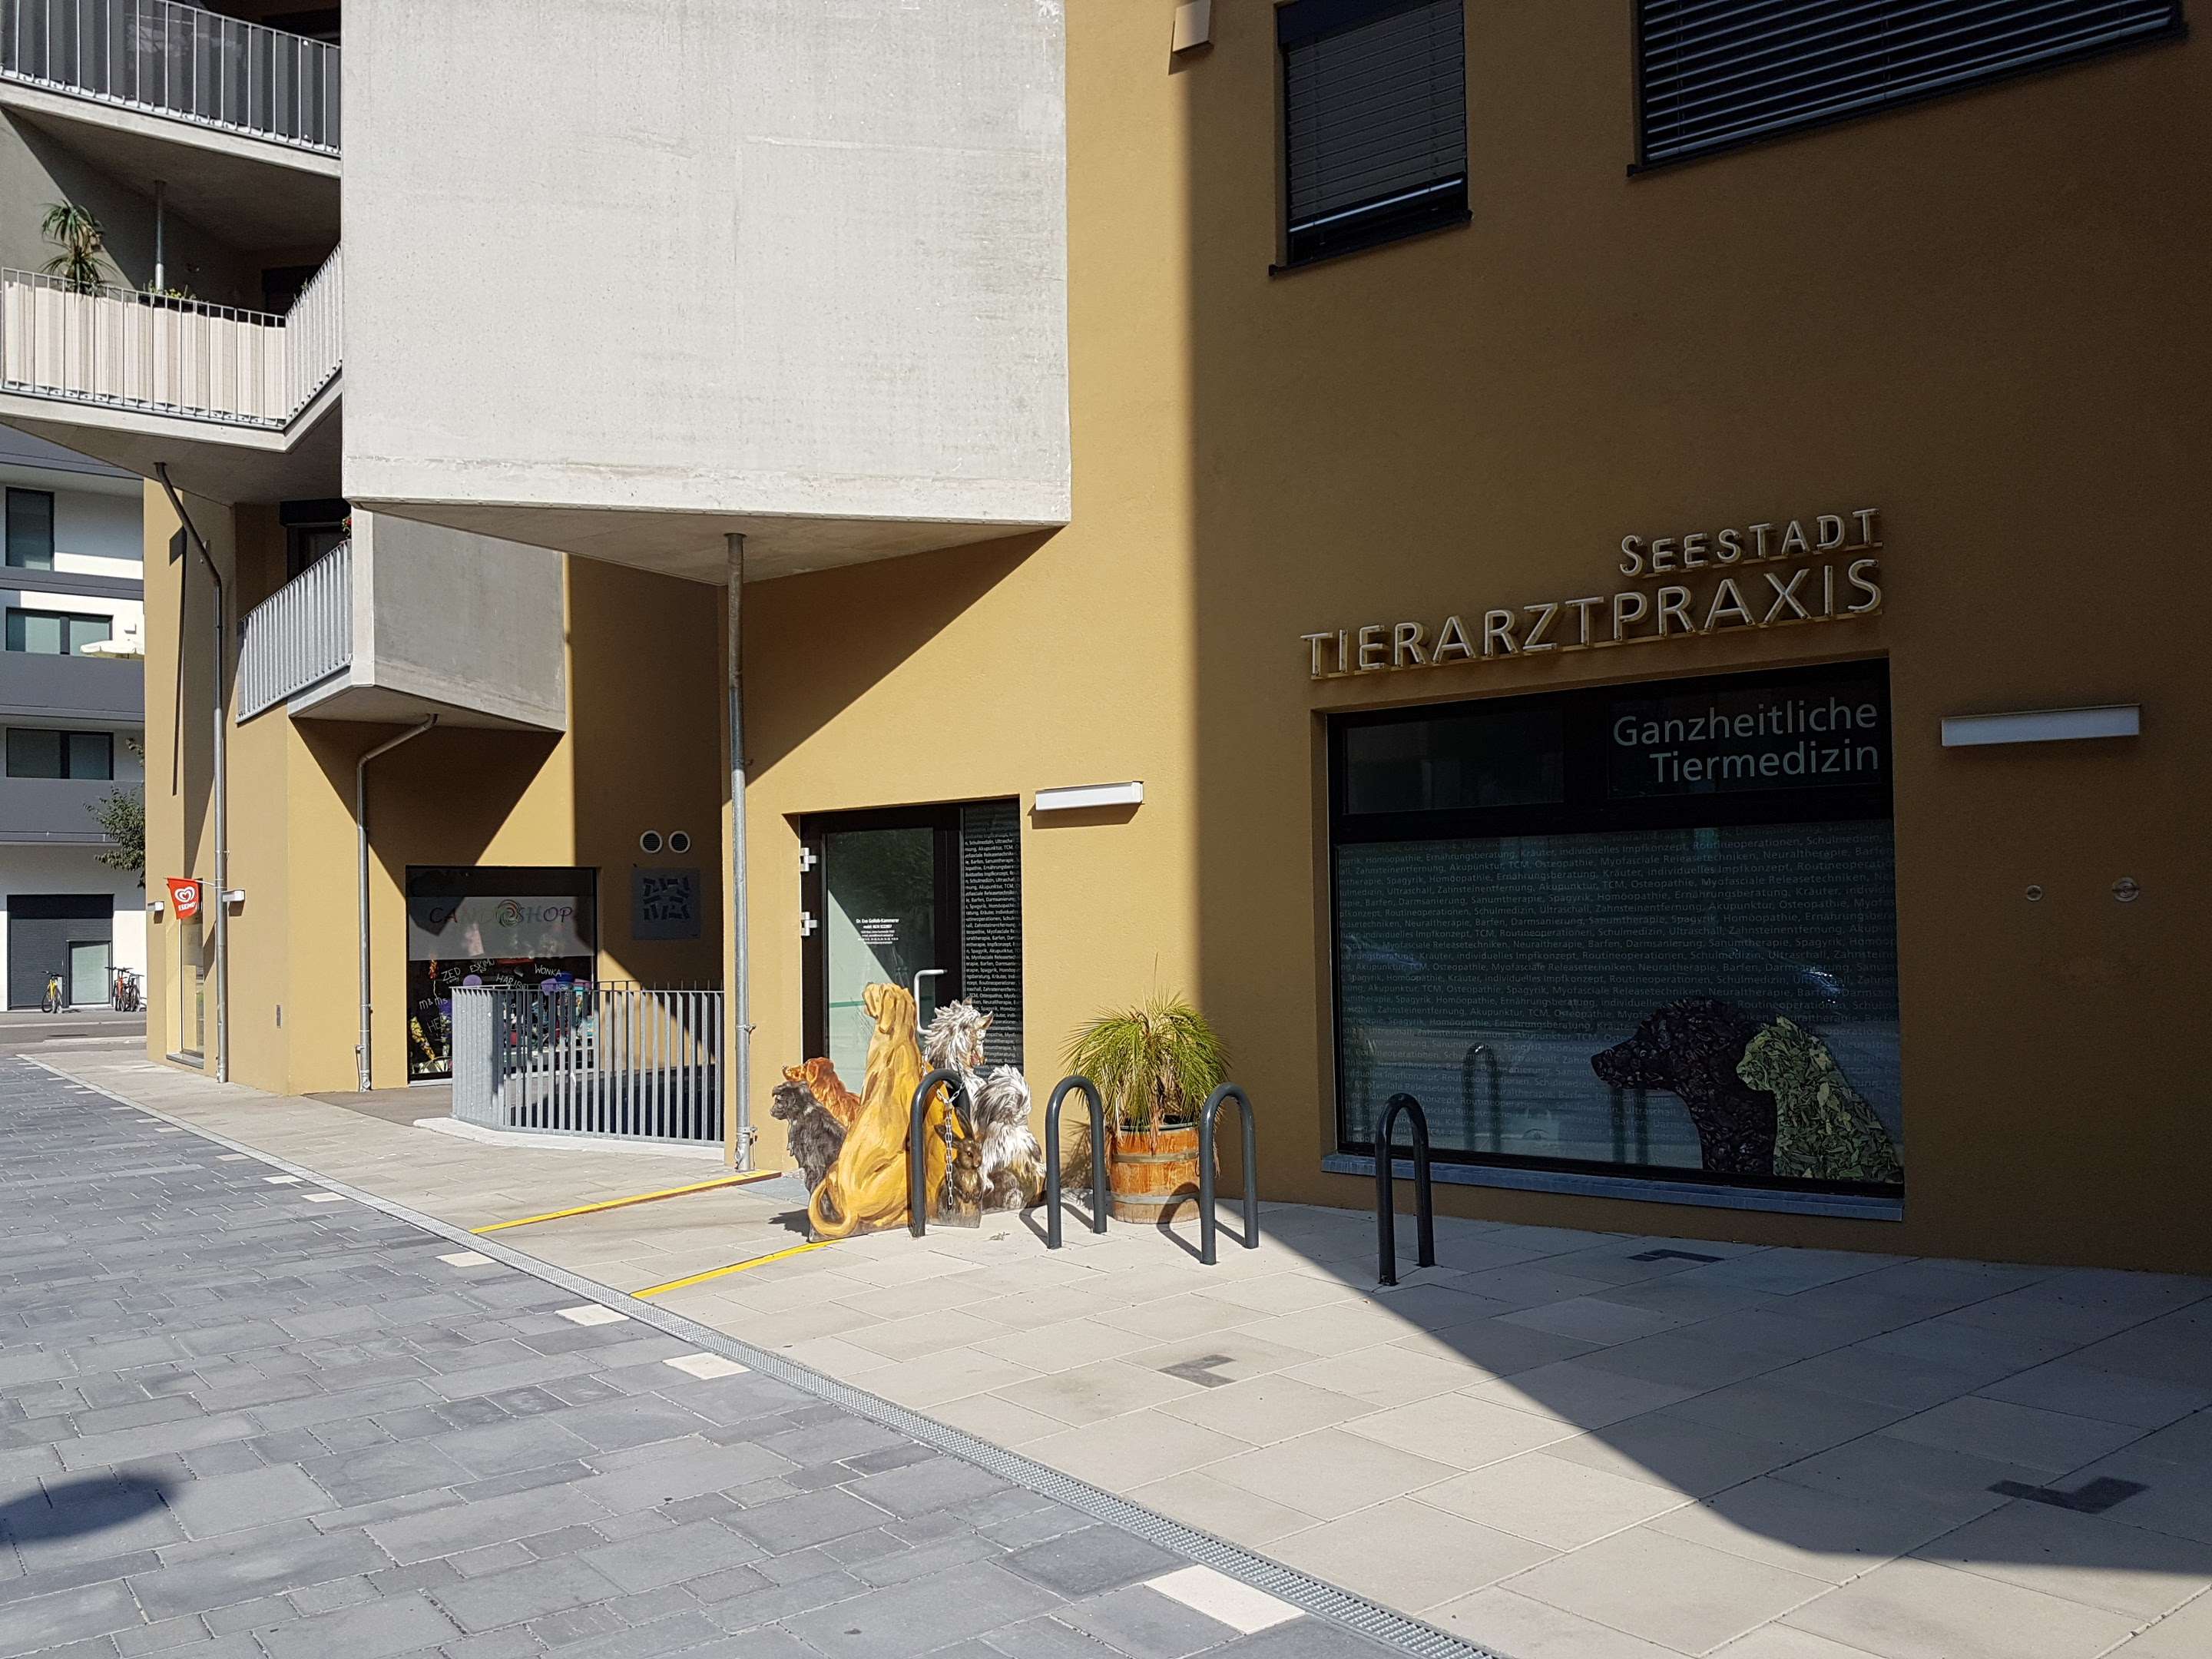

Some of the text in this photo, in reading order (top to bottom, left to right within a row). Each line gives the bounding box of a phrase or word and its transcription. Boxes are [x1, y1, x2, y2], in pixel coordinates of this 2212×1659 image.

[1619, 508, 1880, 577] SEESTADT
[1300, 558, 1883, 678] TIERARZTPRAXIS
[1613, 696, 1878, 747] Ganzheitliche
[1649, 738, 1879, 783] Tiermedizin
[535, 964, 561, 977] WONKA
